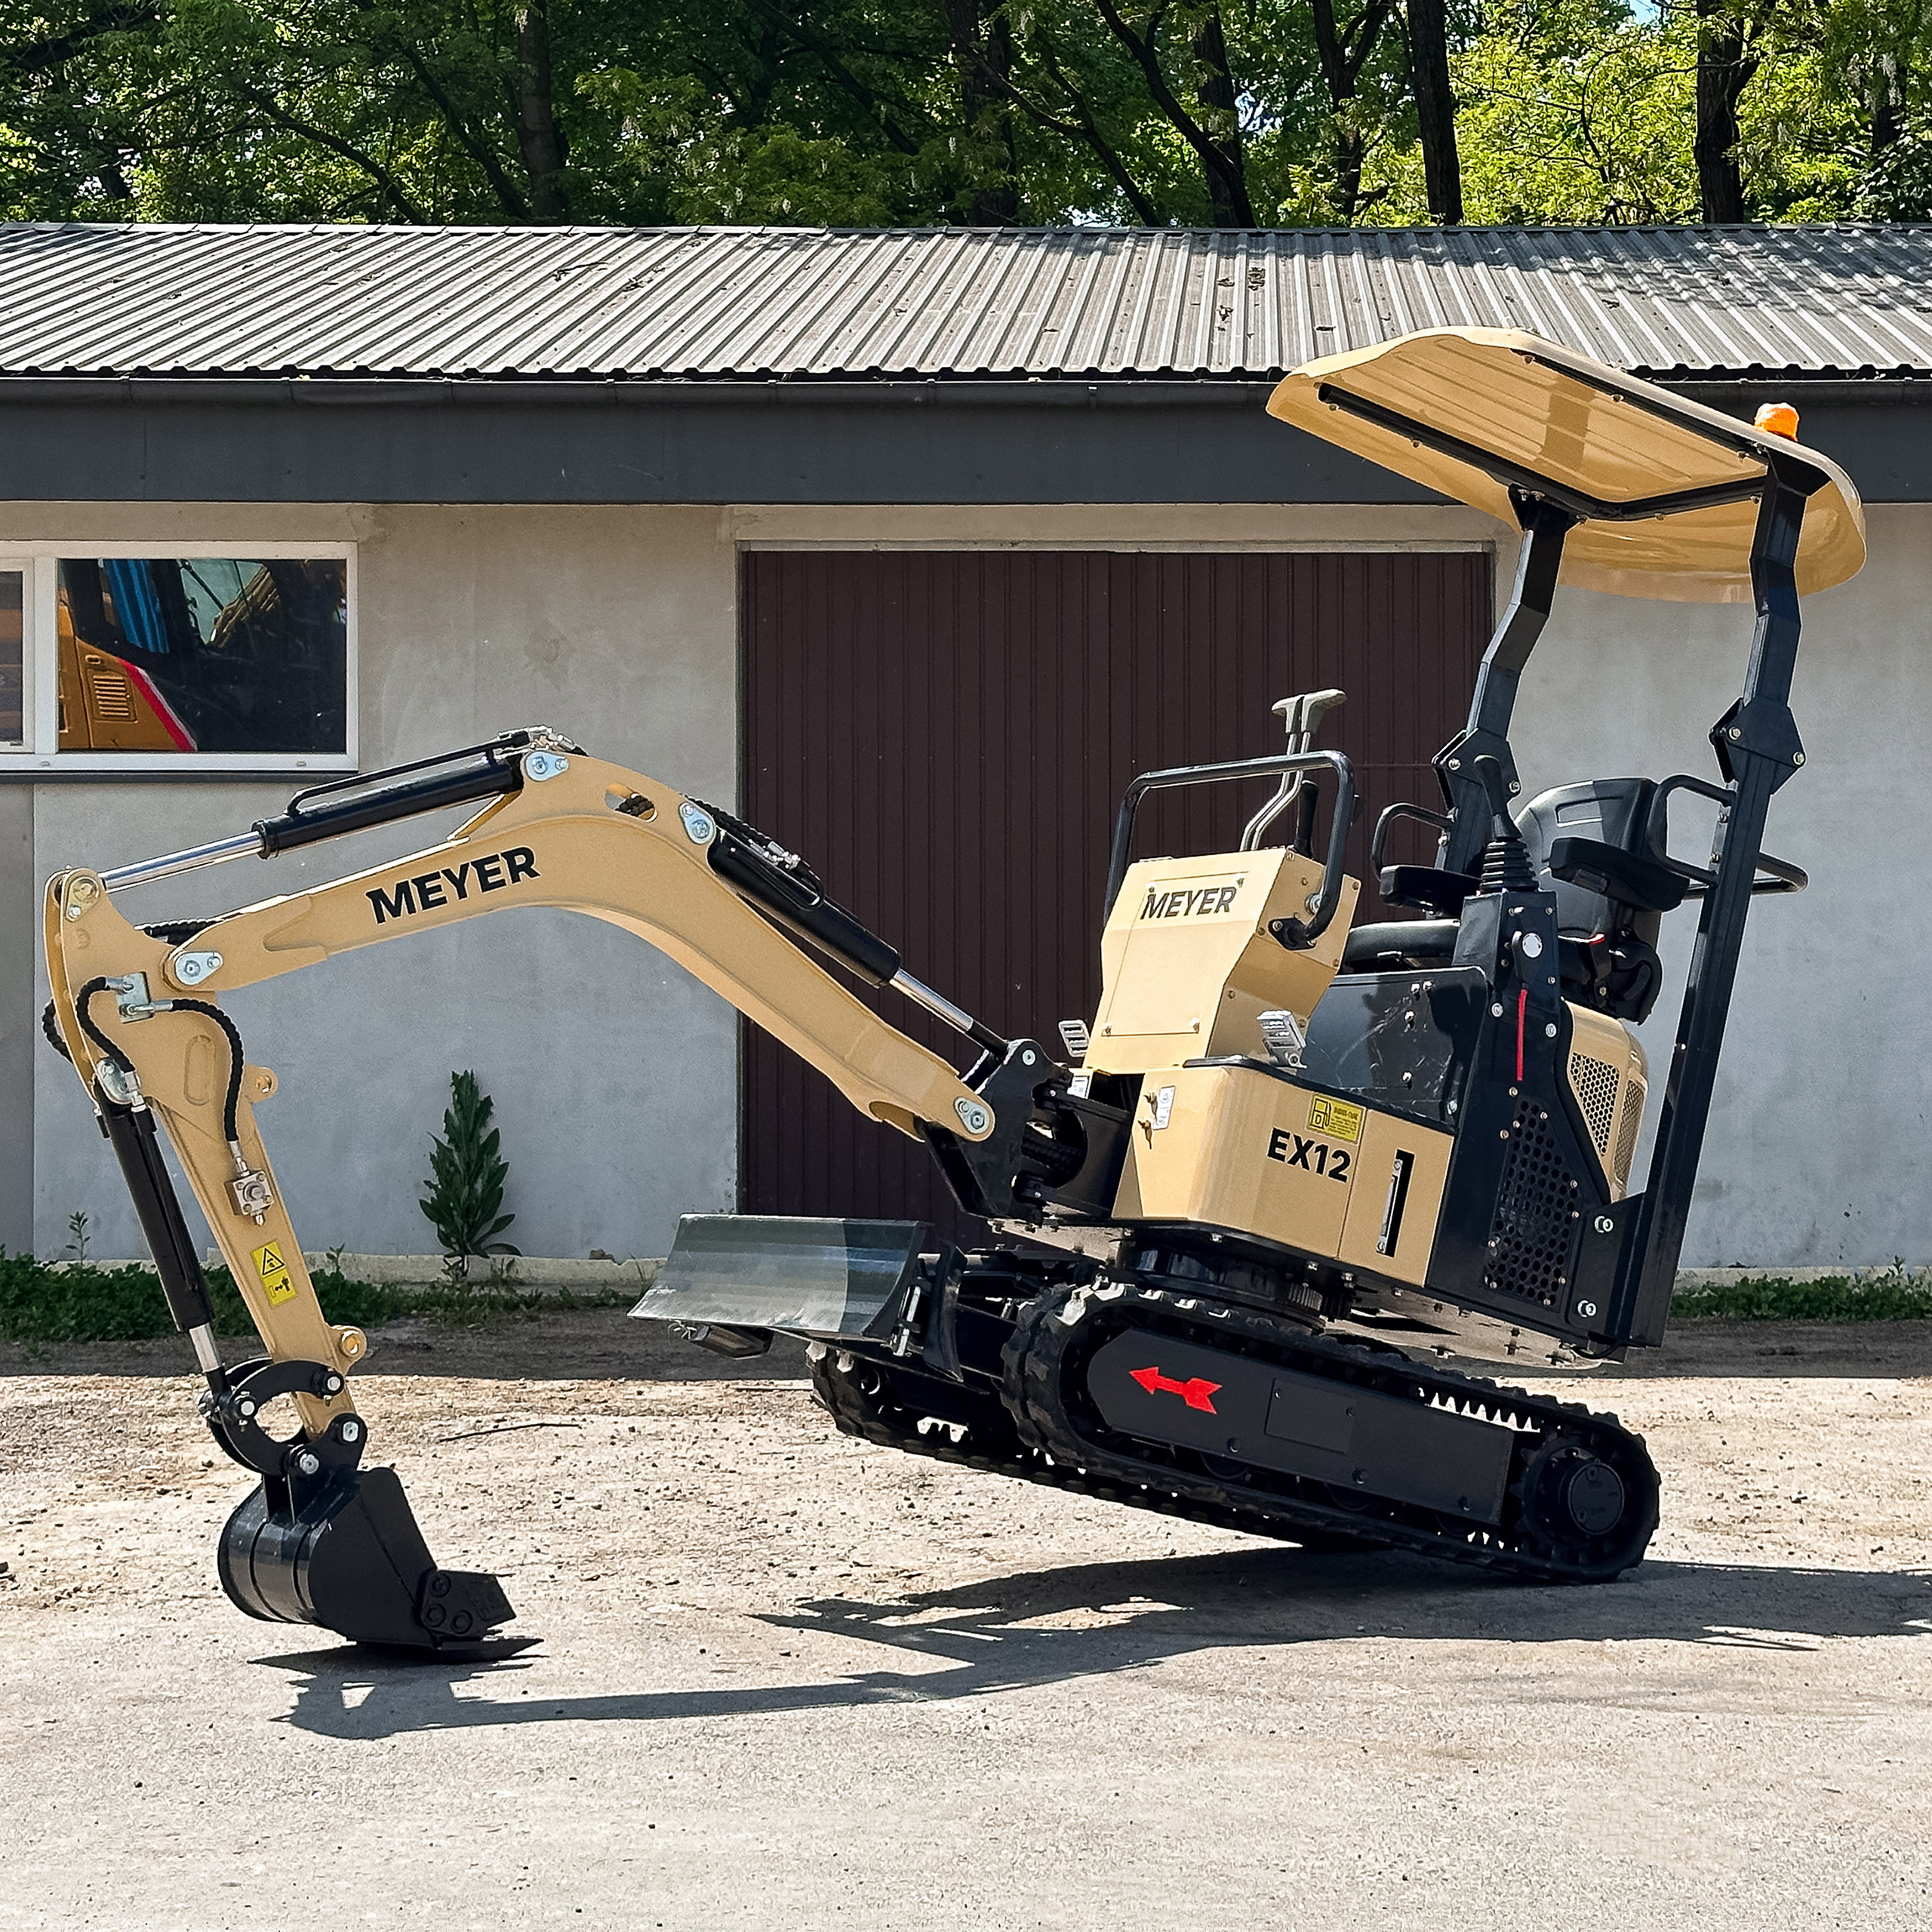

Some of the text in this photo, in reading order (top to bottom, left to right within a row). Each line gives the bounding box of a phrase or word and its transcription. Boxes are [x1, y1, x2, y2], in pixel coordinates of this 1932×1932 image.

[366, 846, 541, 924] MEYER
[1140, 887, 1237, 920] MEYER
[1267, 1128, 1351, 1183] EX12
